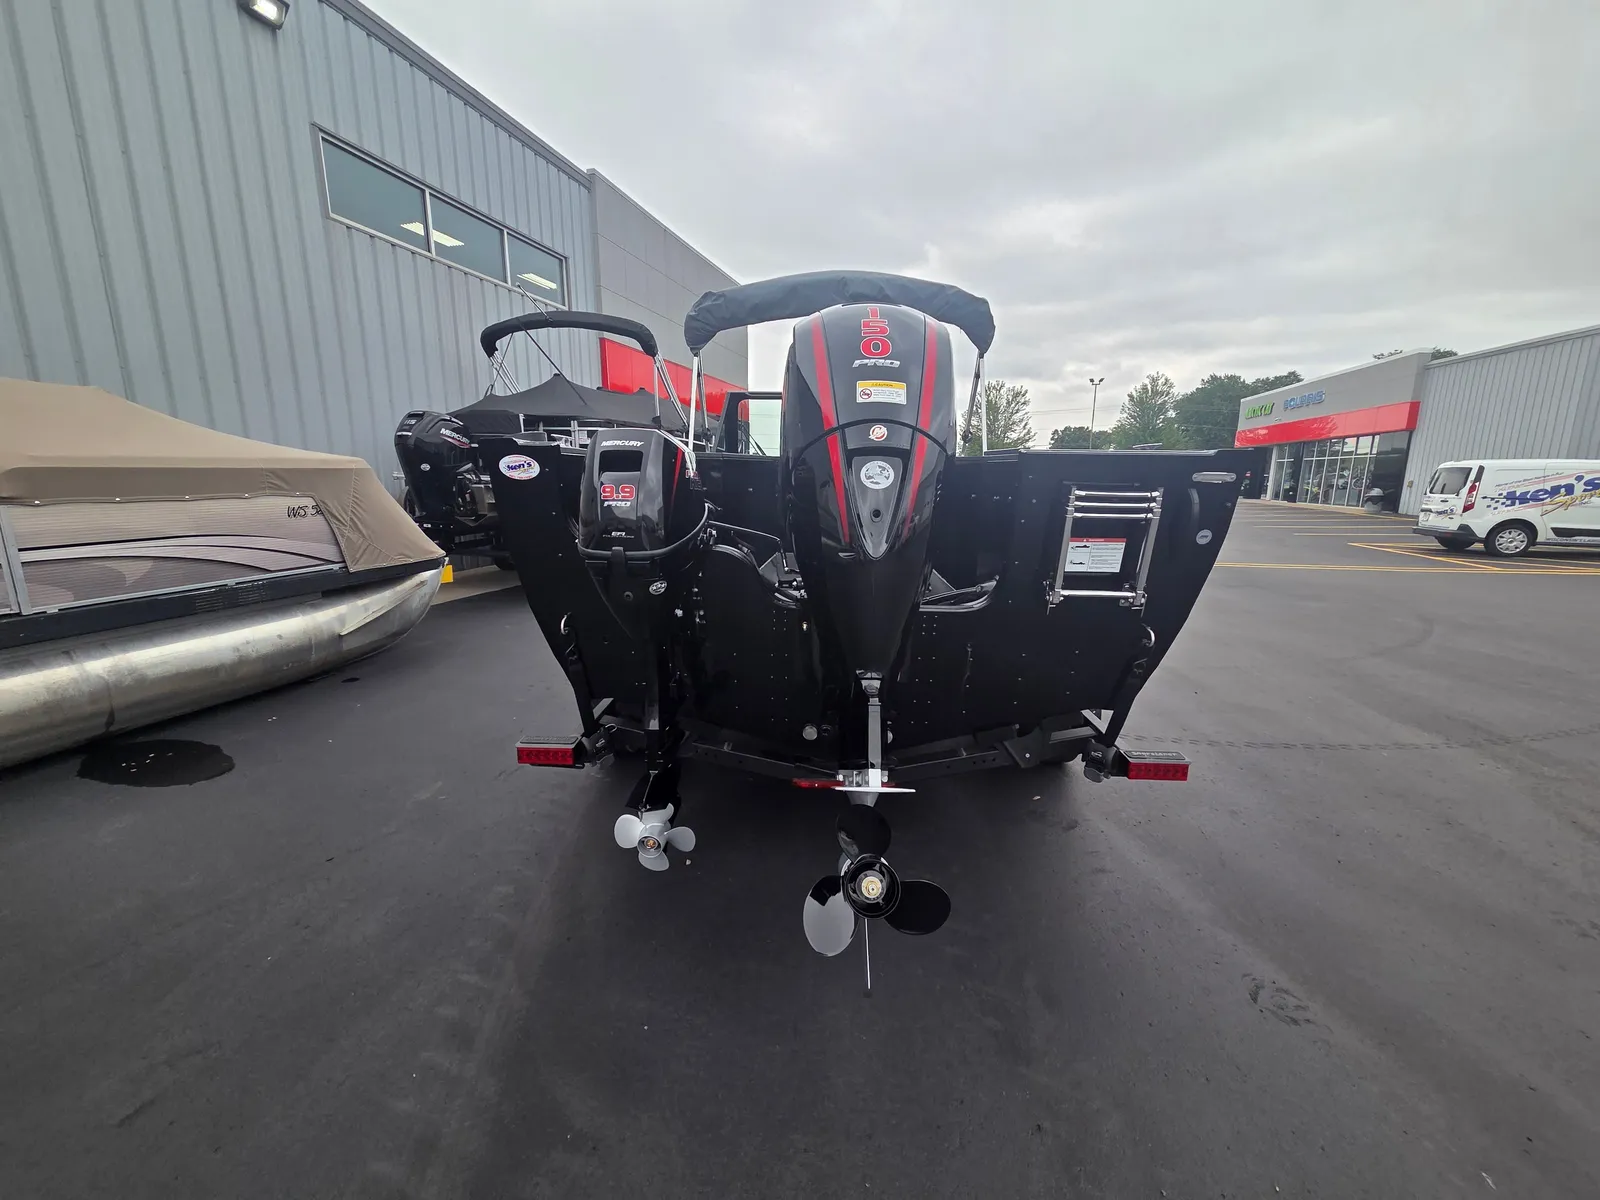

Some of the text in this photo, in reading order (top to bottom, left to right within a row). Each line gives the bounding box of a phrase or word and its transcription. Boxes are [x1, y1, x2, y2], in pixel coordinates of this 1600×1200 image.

[860, 306, 892, 358] 150
[852, 358, 900, 367] PRO
[1283, 389, 1326, 410] POLARIS
[440, 427, 470, 444] MERCURY
[601, 485, 636, 500] 9.9
[287, 505, 308, 518] WS
